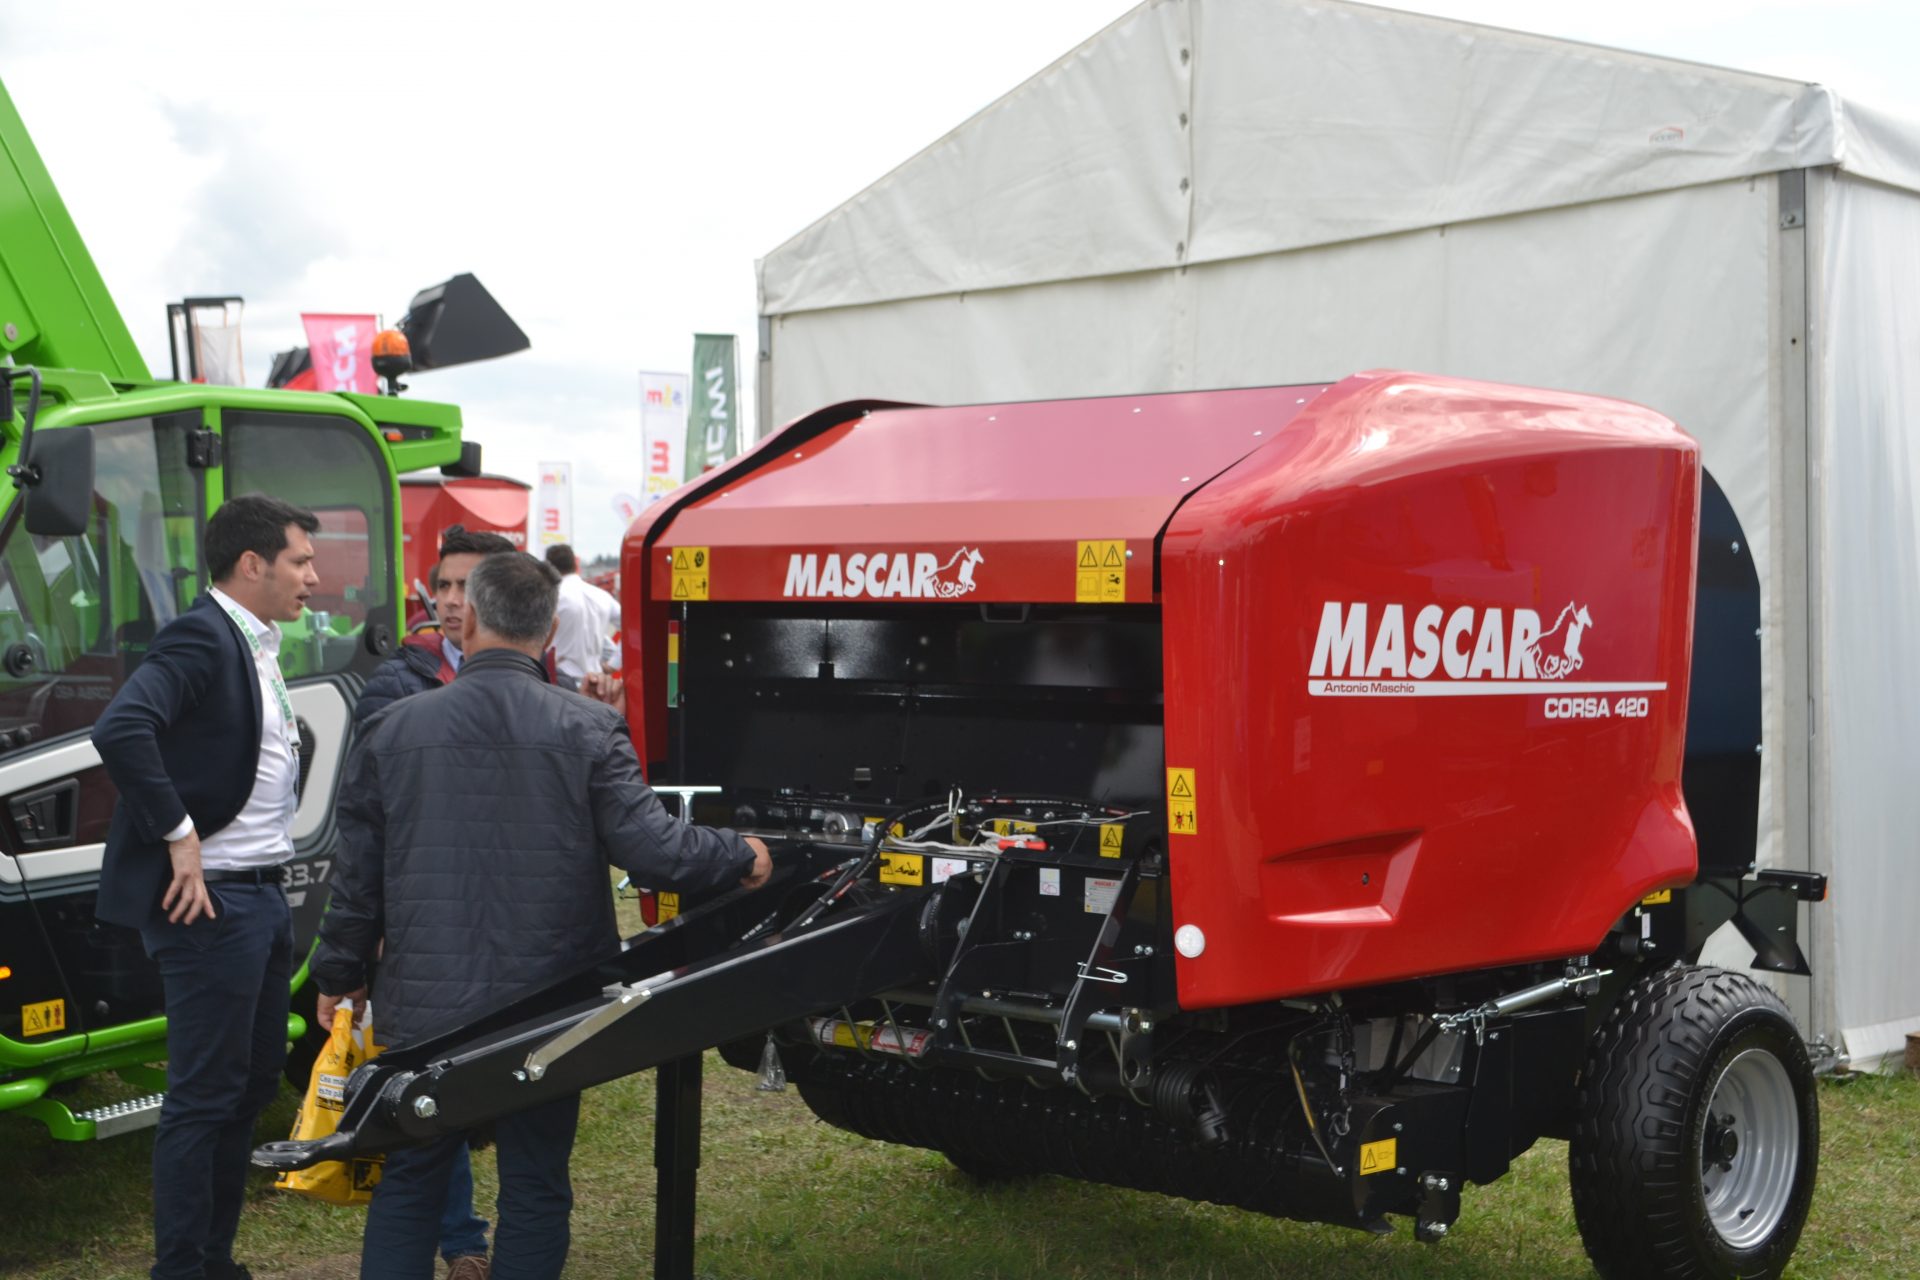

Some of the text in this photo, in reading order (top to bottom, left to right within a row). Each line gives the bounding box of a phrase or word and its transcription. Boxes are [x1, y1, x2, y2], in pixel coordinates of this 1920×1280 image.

[783, 553, 939, 598] MASCAR
[1308, 601, 1541, 680] MASCAR
[1324, 682, 1415, 694] Antonio Maschio
[1544, 697, 1649, 719] CORSA 420
